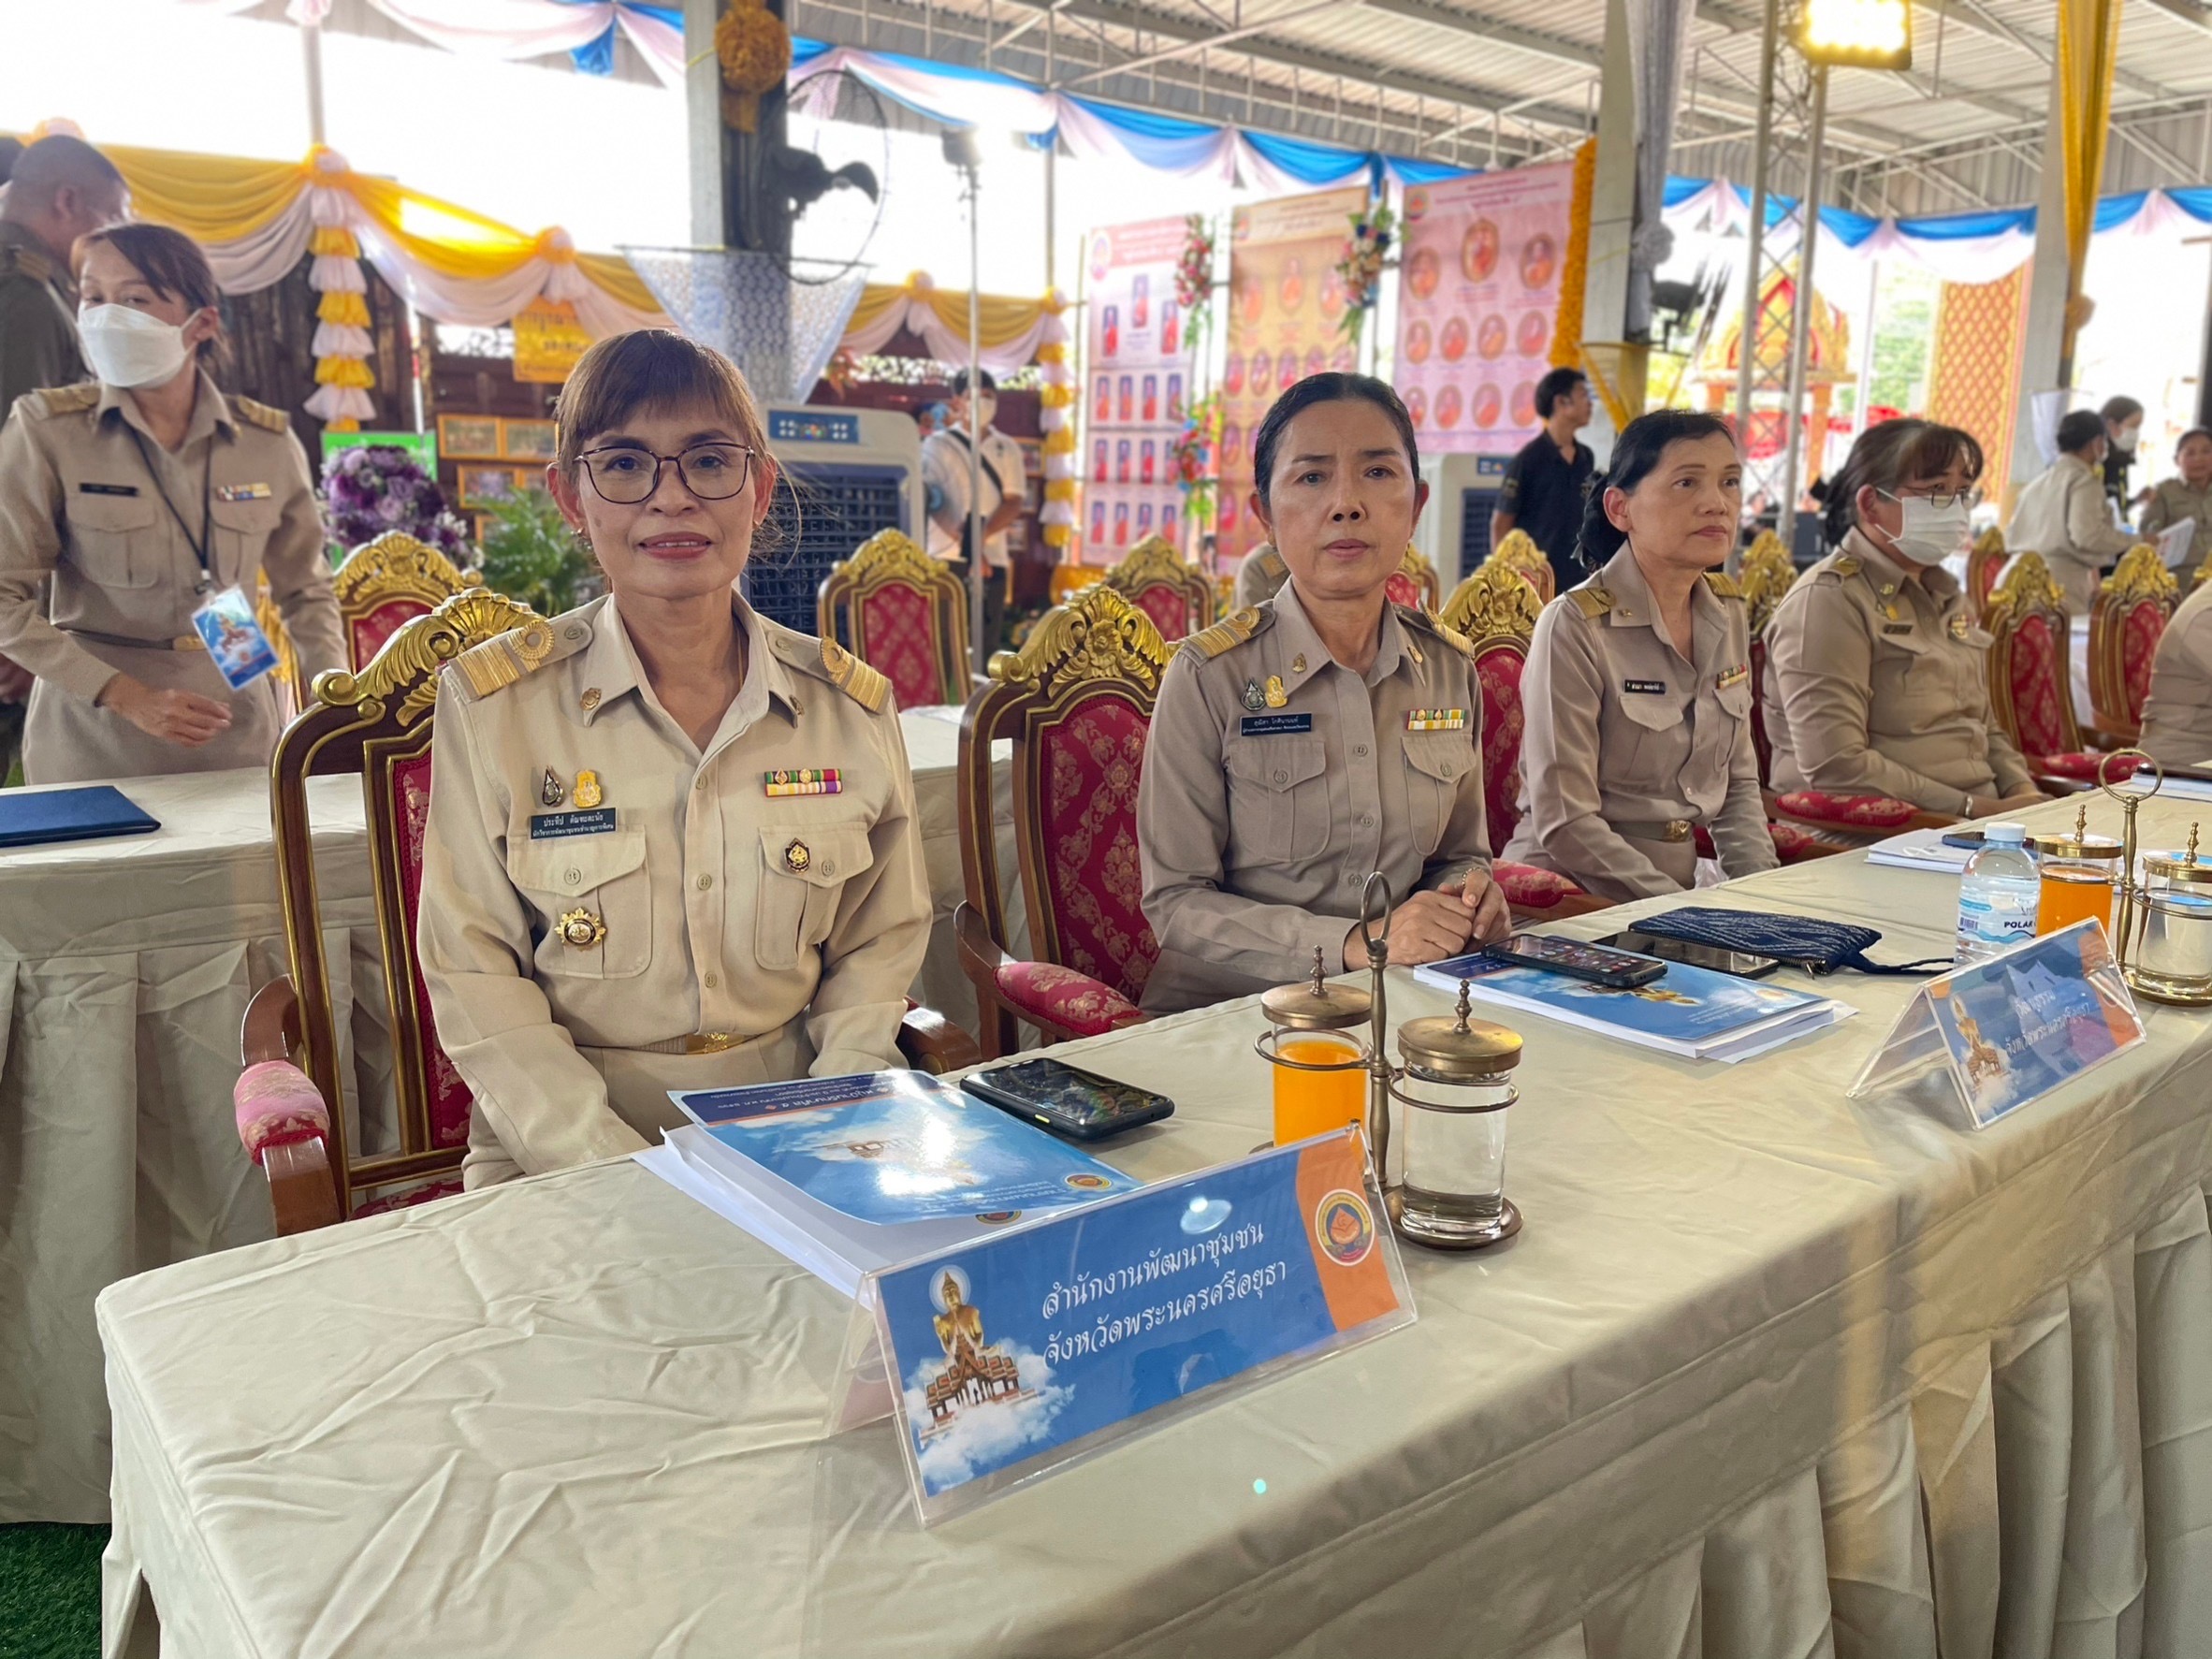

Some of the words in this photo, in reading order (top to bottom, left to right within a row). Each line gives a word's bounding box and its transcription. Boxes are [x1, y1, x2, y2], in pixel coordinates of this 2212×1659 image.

[1041, 1222, 1264, 1319] สำนักงานพัฒนาชุมชน
[1043, 1260, 1287, 1366] จังหวัดพระนครศรีอยุธา
